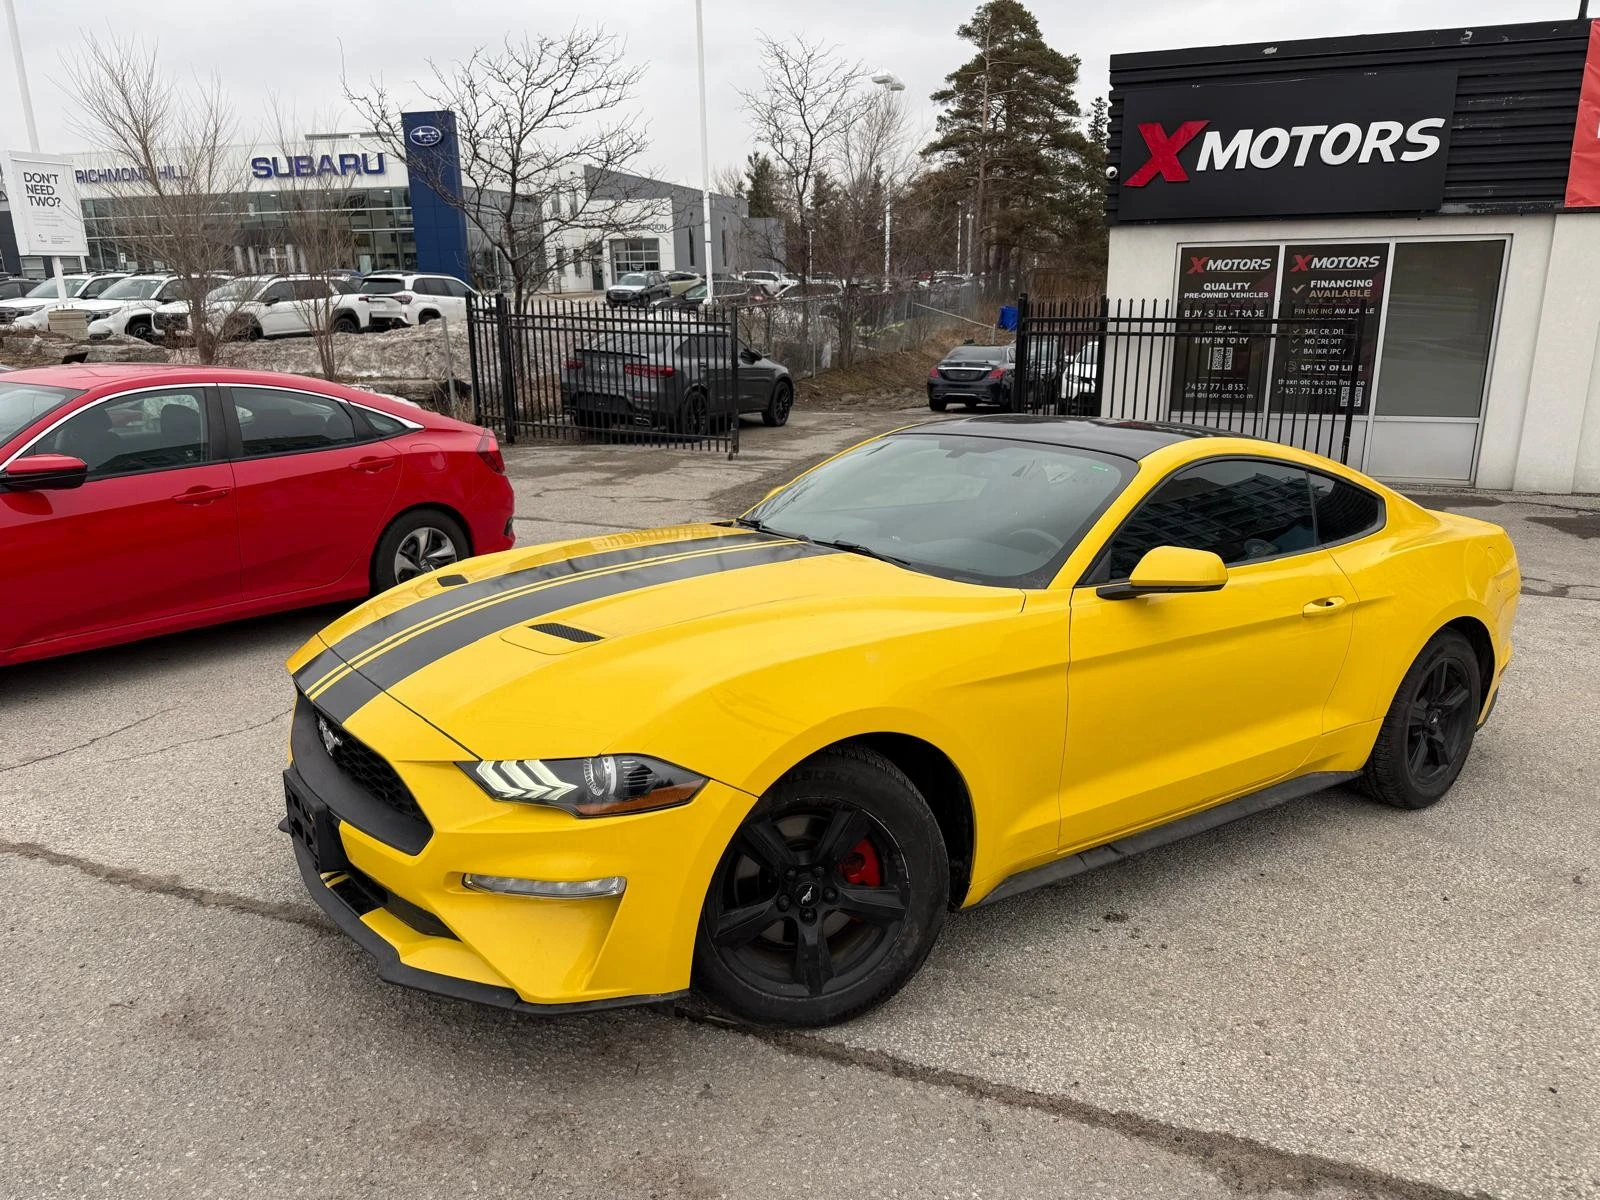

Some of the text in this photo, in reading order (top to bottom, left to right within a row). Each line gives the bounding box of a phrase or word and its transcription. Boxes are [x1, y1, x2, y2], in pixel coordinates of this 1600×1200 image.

[1196, 117, 1446, 171] MOTORS
[251, 153, 385, 178] SUBARU
[23, 172, 59, 185] DON'T
[75, 165, 190, 183] RICHMOND HILL
[25, 184, 55, 196] NEED
[27, 196, 61, 208] TWO?
[1206, 258, 1271, 271] MOTORS
[1310, 255, 1380, 269] MOTORS
[1203, 282, 1251, 291] QUALITY
[1310, 279, 1373, 288] FINANCING
[1308, 289, 1371, 298] AVAILABLE
[1334, 307, 1375, 315] AVILALE
